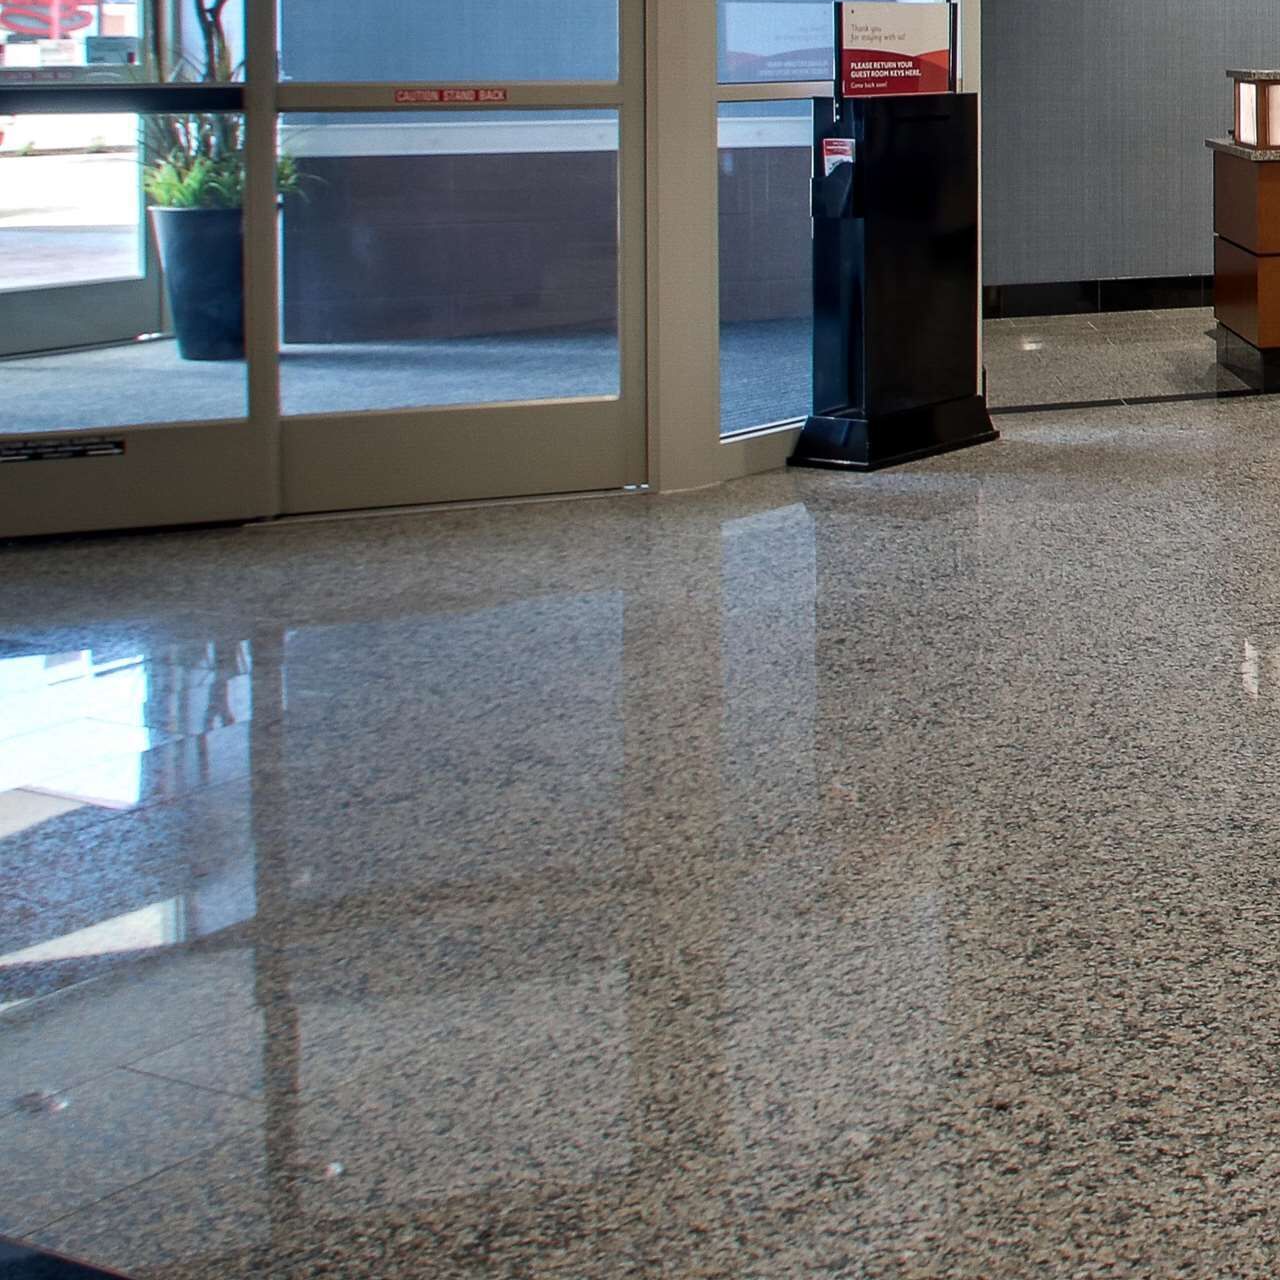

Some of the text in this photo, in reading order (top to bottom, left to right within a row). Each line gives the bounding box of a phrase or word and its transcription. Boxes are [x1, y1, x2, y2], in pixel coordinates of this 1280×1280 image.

[850, 61, 913, 70] PLEASE RETURN YOUR
[850, 70, 870, 79] GUEST
[870, 70, 889, 78] ROOM
[890, 69, 905, 77] KEYS
[850, 81, 864, 89] Come
[396, 89, 505, 101] CAUTION STAND BACK
